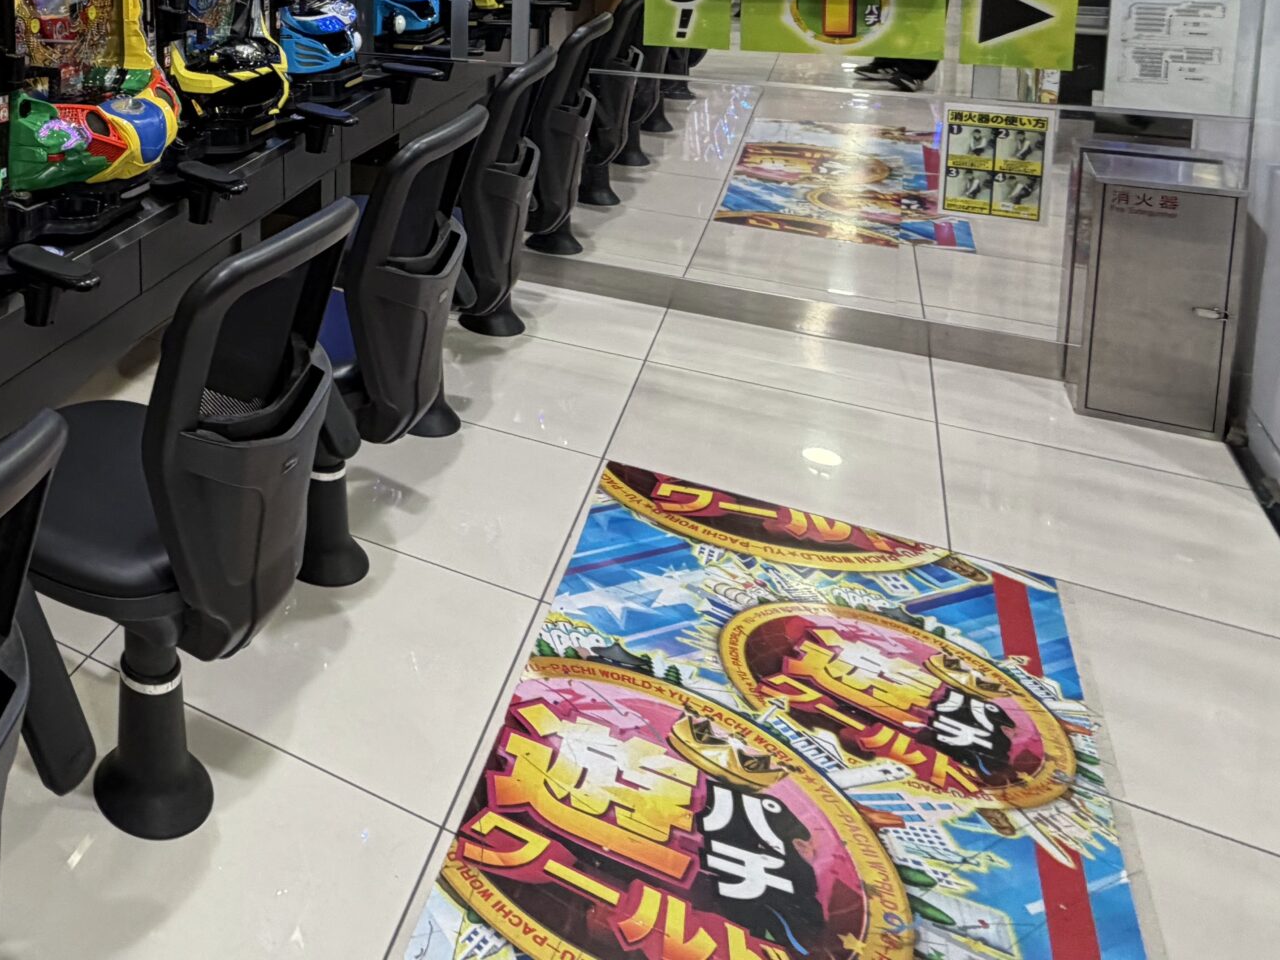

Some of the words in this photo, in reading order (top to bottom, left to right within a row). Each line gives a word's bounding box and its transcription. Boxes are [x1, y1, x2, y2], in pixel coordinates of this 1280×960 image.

[950, 112, 1047, 129] 消火器の使い方
[1111, 191, 1180, 209] 消火器
[601, 669, 652, 689] WORLD
[669, 688, 751, 737] YU-PACHI
